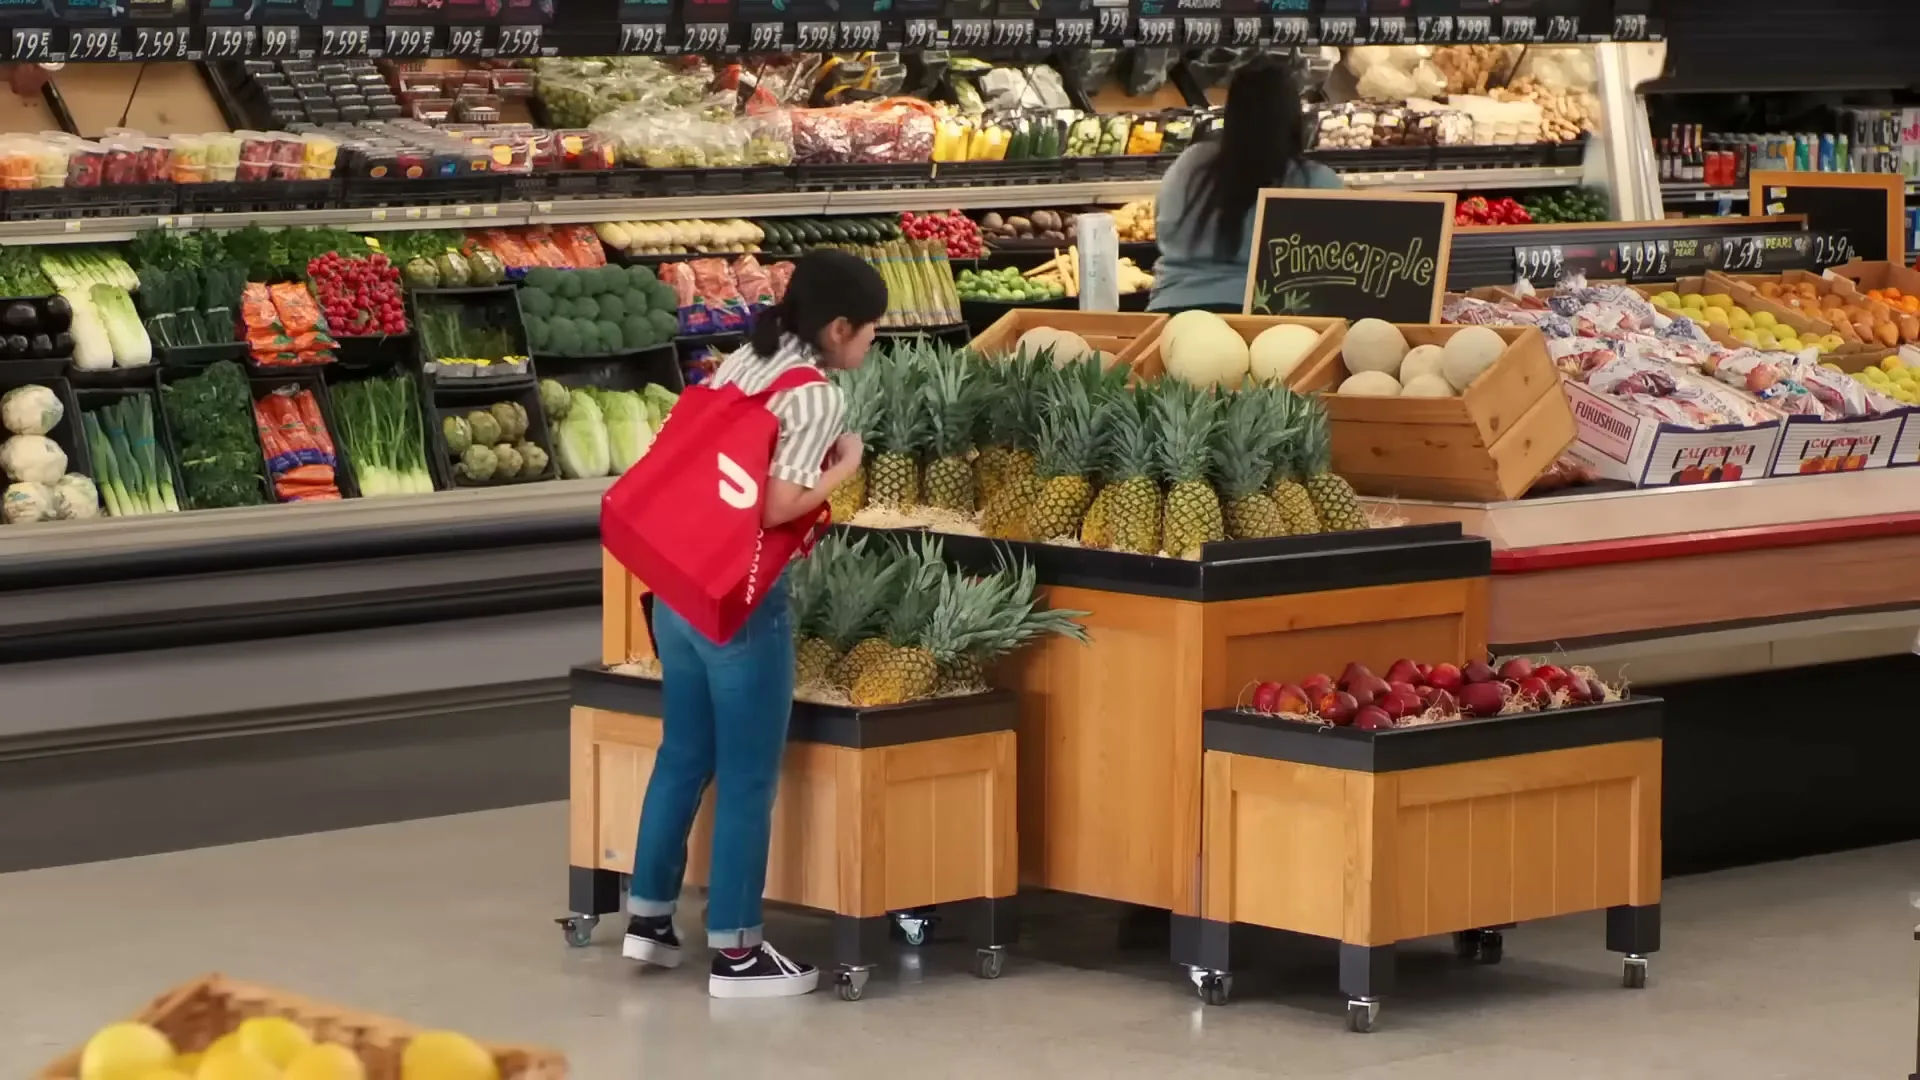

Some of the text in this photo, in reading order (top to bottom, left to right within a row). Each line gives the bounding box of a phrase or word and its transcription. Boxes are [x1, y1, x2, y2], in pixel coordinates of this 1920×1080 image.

[70, 32, 108, 59] 2.99
[135, 31, 174, 59] 2.59
[208, 30, 242, 57] 1.59
[323, 30, 358, 56] 2.59
[386, 30, 421, 56] 1.99
[498, 29, 533, 55] 2.59
[683, 28, 717, 52] 2.99
[1765, 236, 1793, 250] PEARS
[1815, 235, 1848, 265] 2.59
[1268, 233, 1433, 298] Pineapple
[1620, 244, 1657, 276] 5.99
[1575, 401, 1632, 441] FUKUSHIMA
